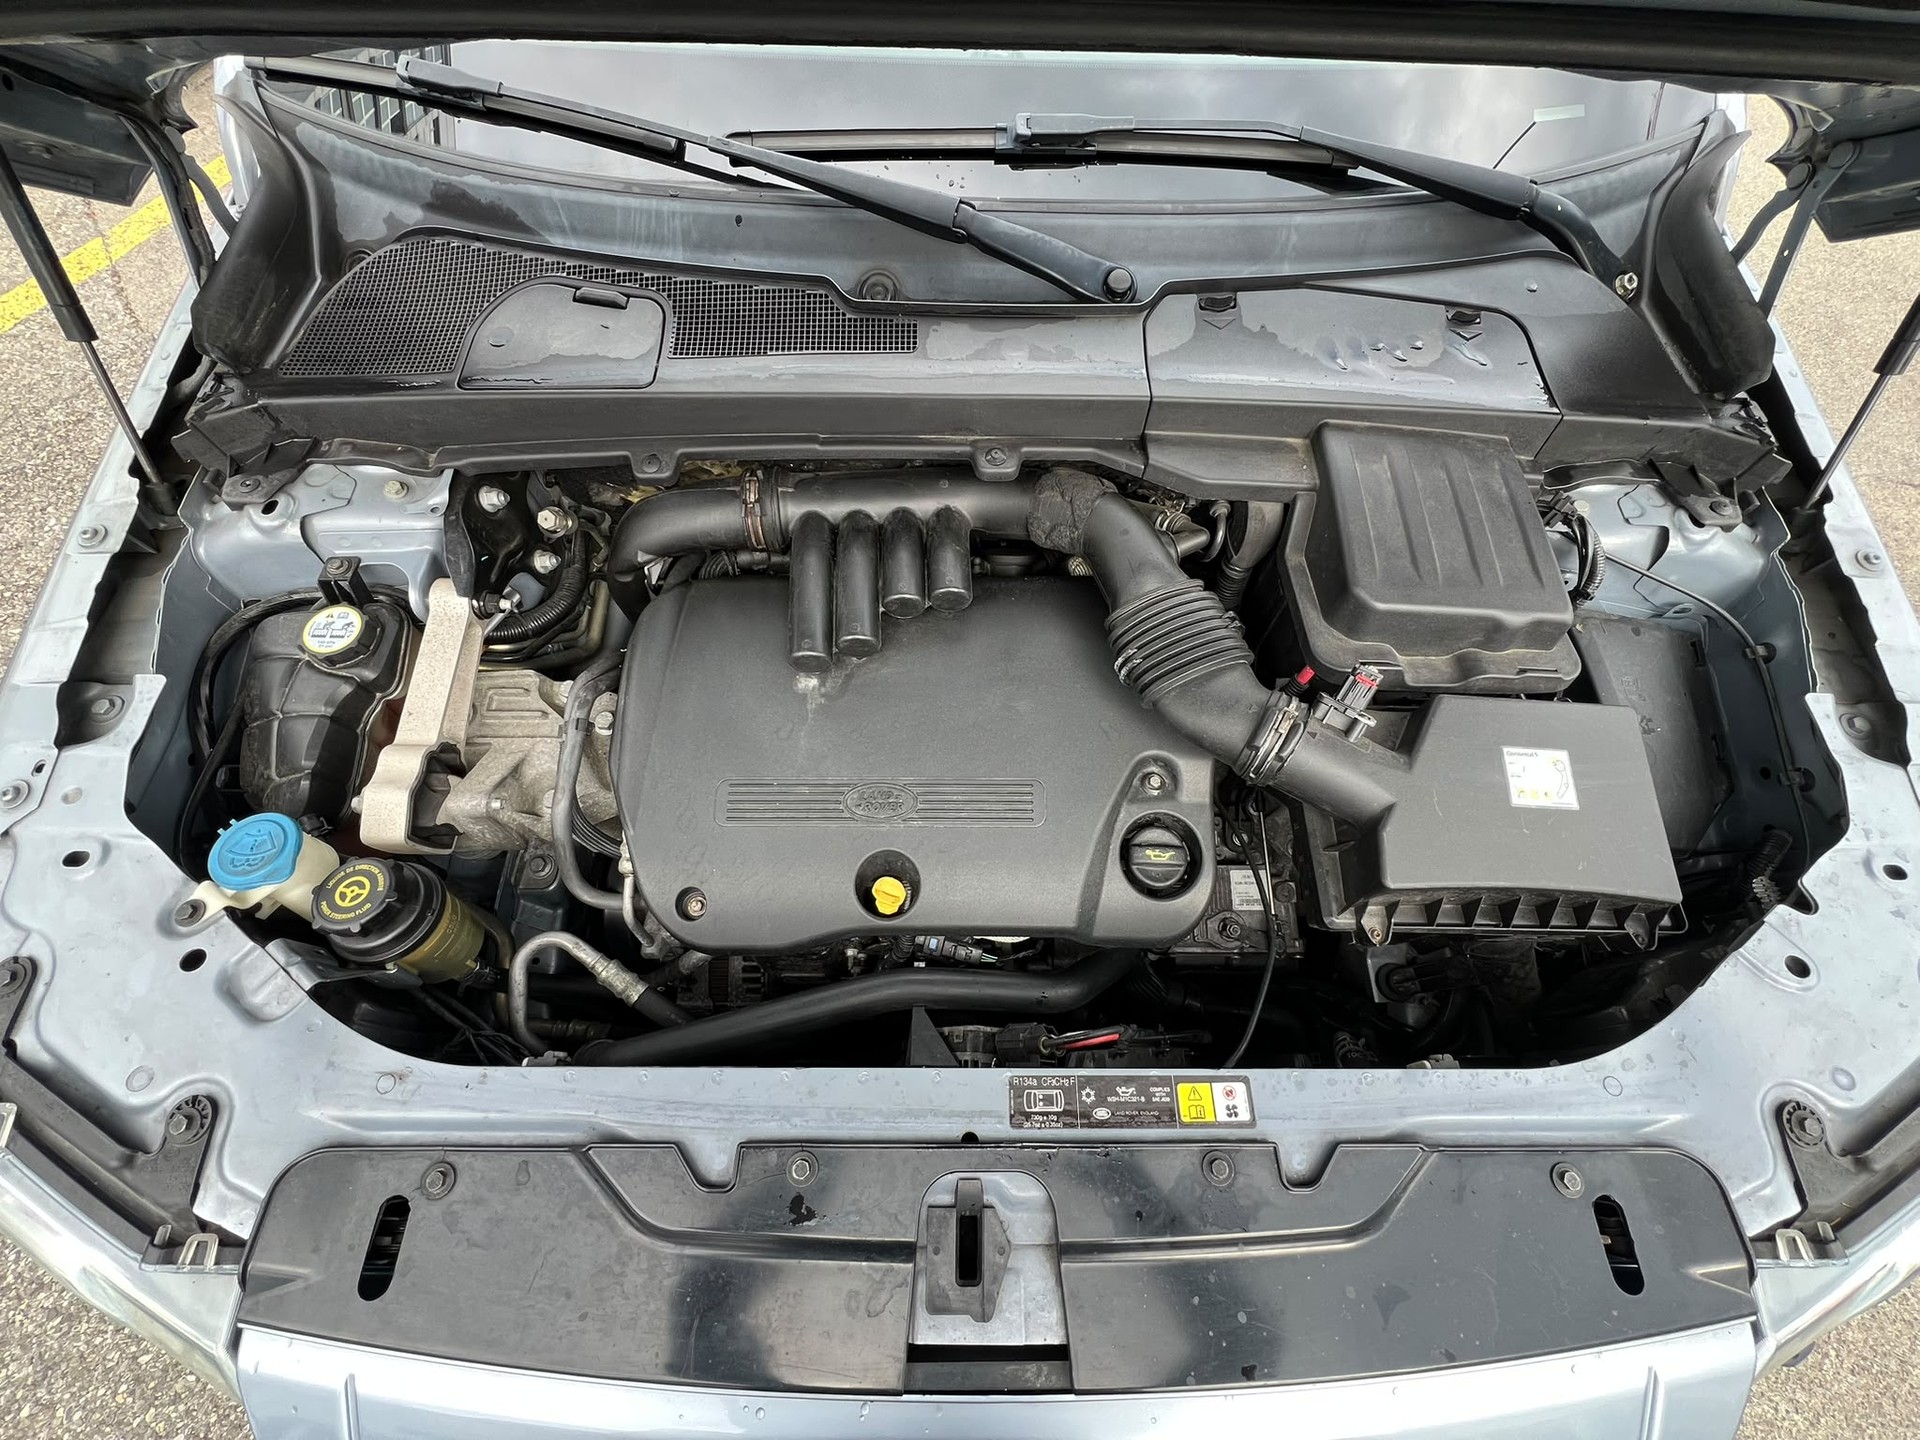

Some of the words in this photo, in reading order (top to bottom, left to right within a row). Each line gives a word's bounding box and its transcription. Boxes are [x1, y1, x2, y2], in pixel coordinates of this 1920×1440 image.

[860, 801, 905, 812] ROVER
[355, 864, 380, 875] DIRECTION
[321, 901, 332, 916] POWER
[329, 912, 356, 920] STEERING
[355, 902, 372, 915] FLUID
[1013, 1077, 1038, 1086] R134a
